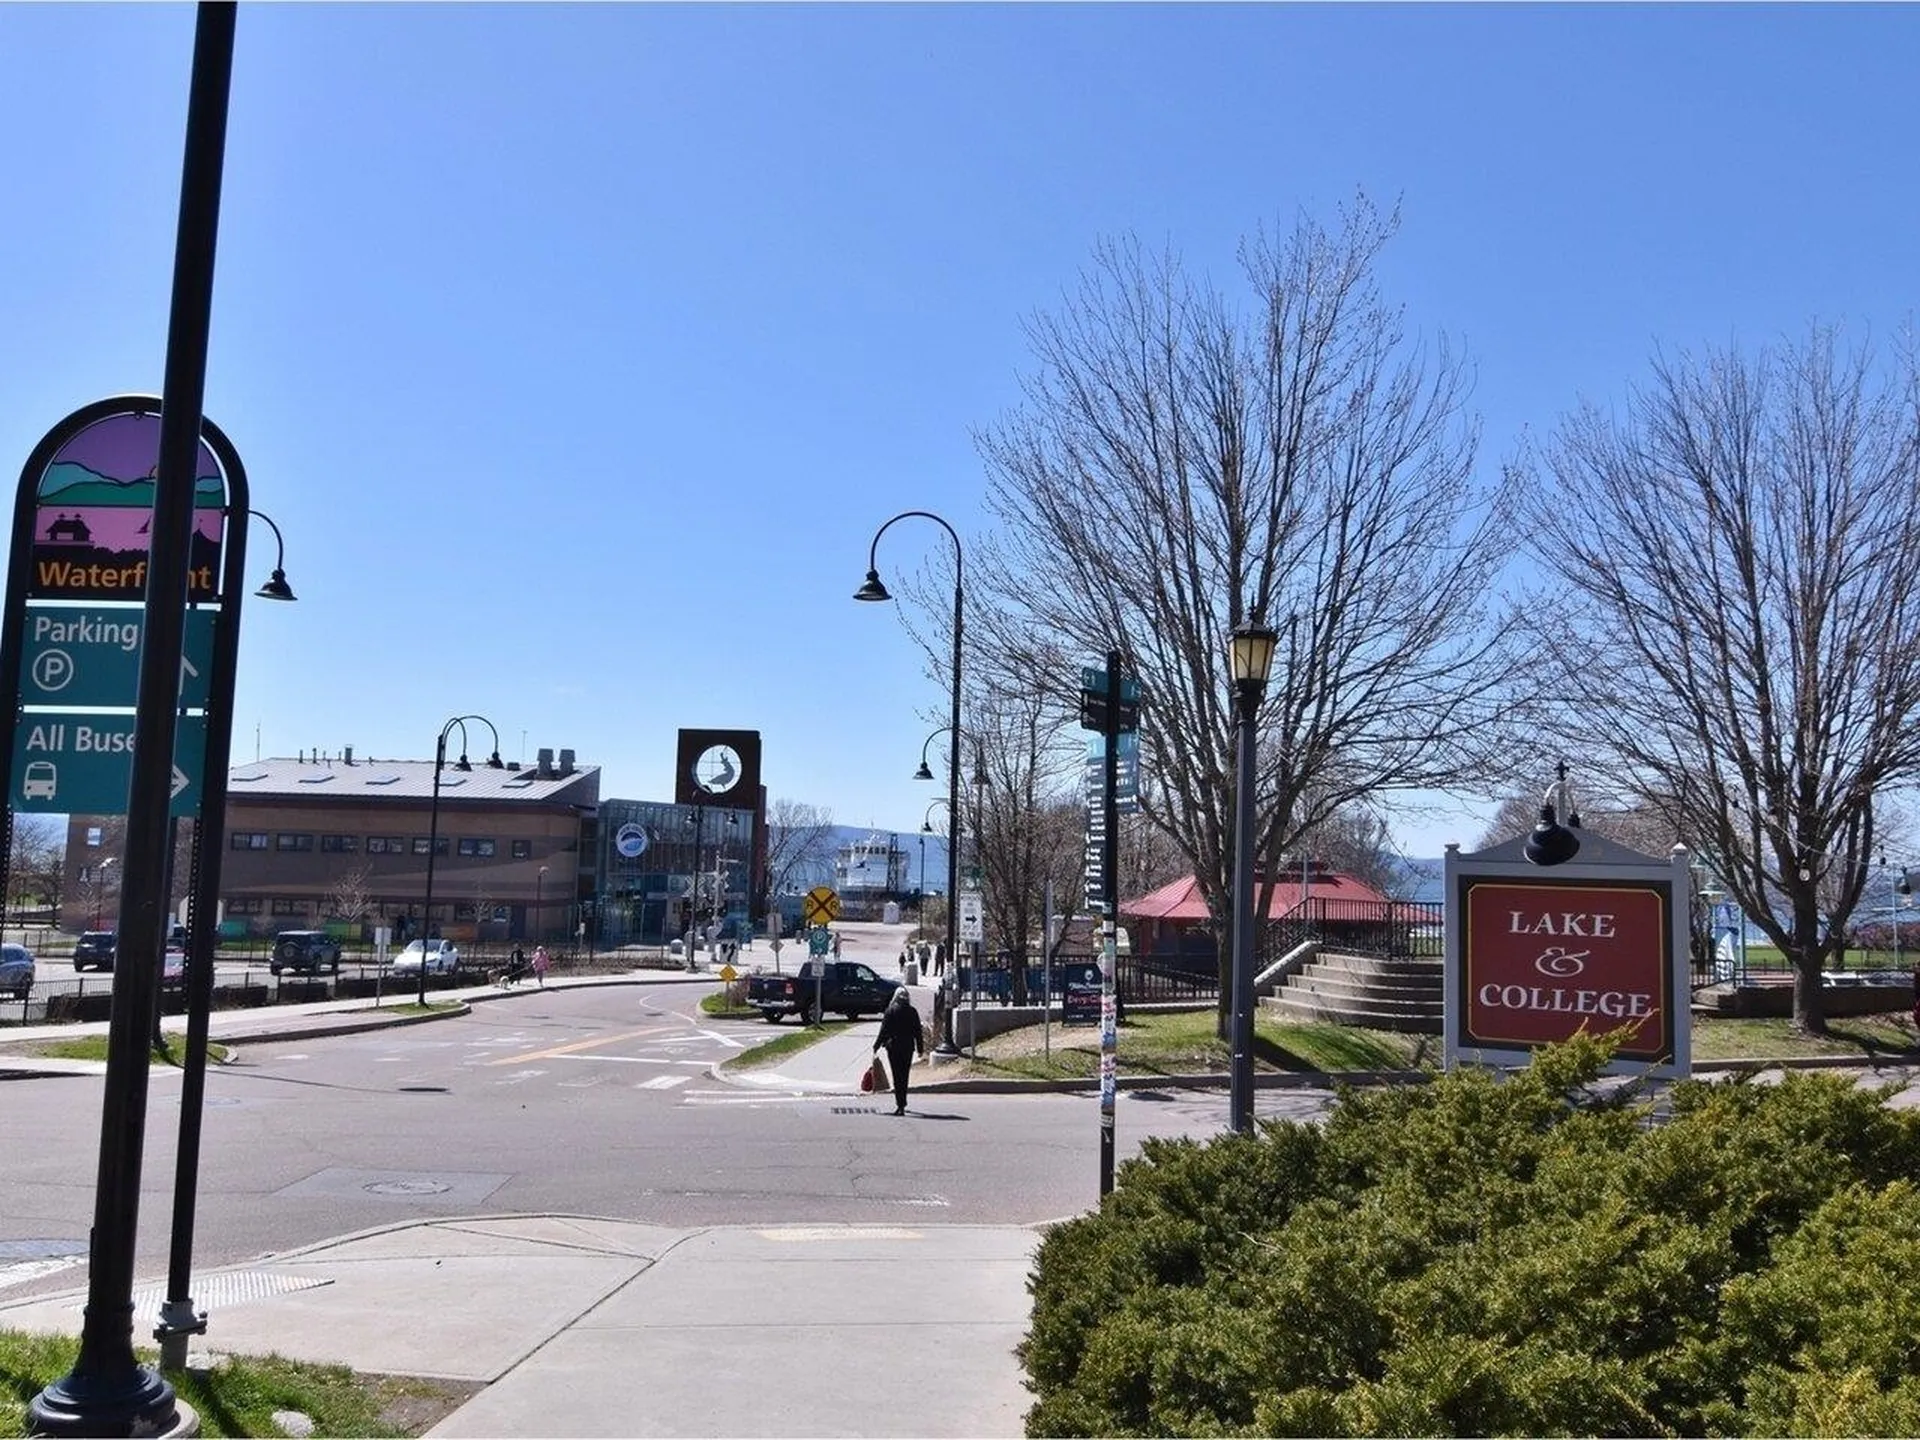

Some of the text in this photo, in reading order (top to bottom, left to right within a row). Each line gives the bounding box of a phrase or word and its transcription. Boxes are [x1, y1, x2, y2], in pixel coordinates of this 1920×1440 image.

[39, 561, 211, 589] Waterfnt
[35, 615, 138, 651] Parking
[45, 657, 65, 682] P
[26, 724, 65, 751] All
[1509, 911, 1615, 938] LAKE
[1535, 947, 1591, 978] &
[1480, 983, 1652, 1018] COLLEGE
